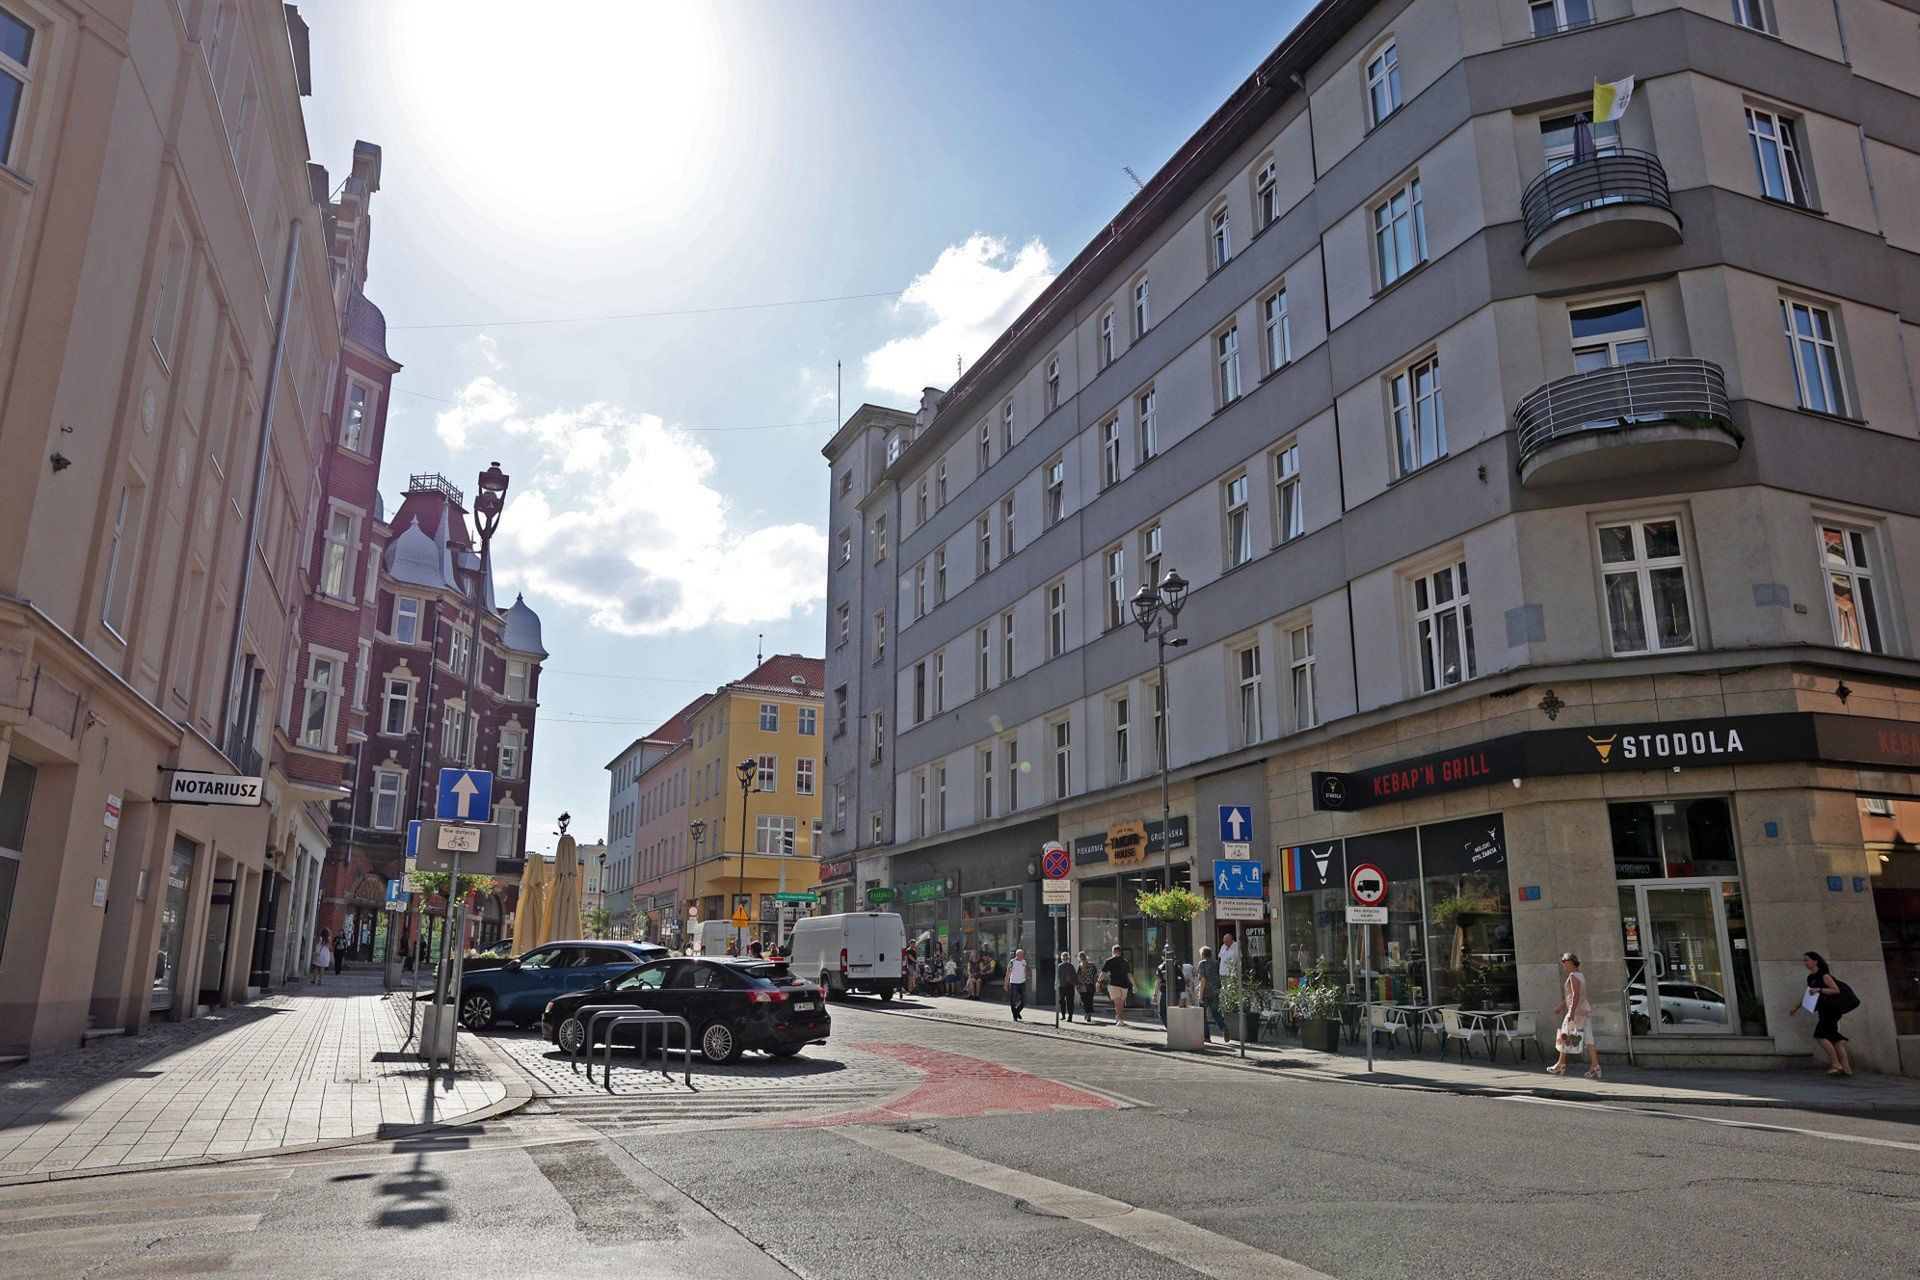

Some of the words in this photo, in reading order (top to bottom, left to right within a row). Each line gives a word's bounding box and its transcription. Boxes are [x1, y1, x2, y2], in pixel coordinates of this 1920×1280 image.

[1622, 729, 1744, 759] STODOLA
[1373, 764, 1435, 796] KEBAP'N
[1443, 753, 1491, 782] GRILL
[174, 780, 257, 798] NOTARIUSZ
[1245, 928, 1266, 936] OPTYK
